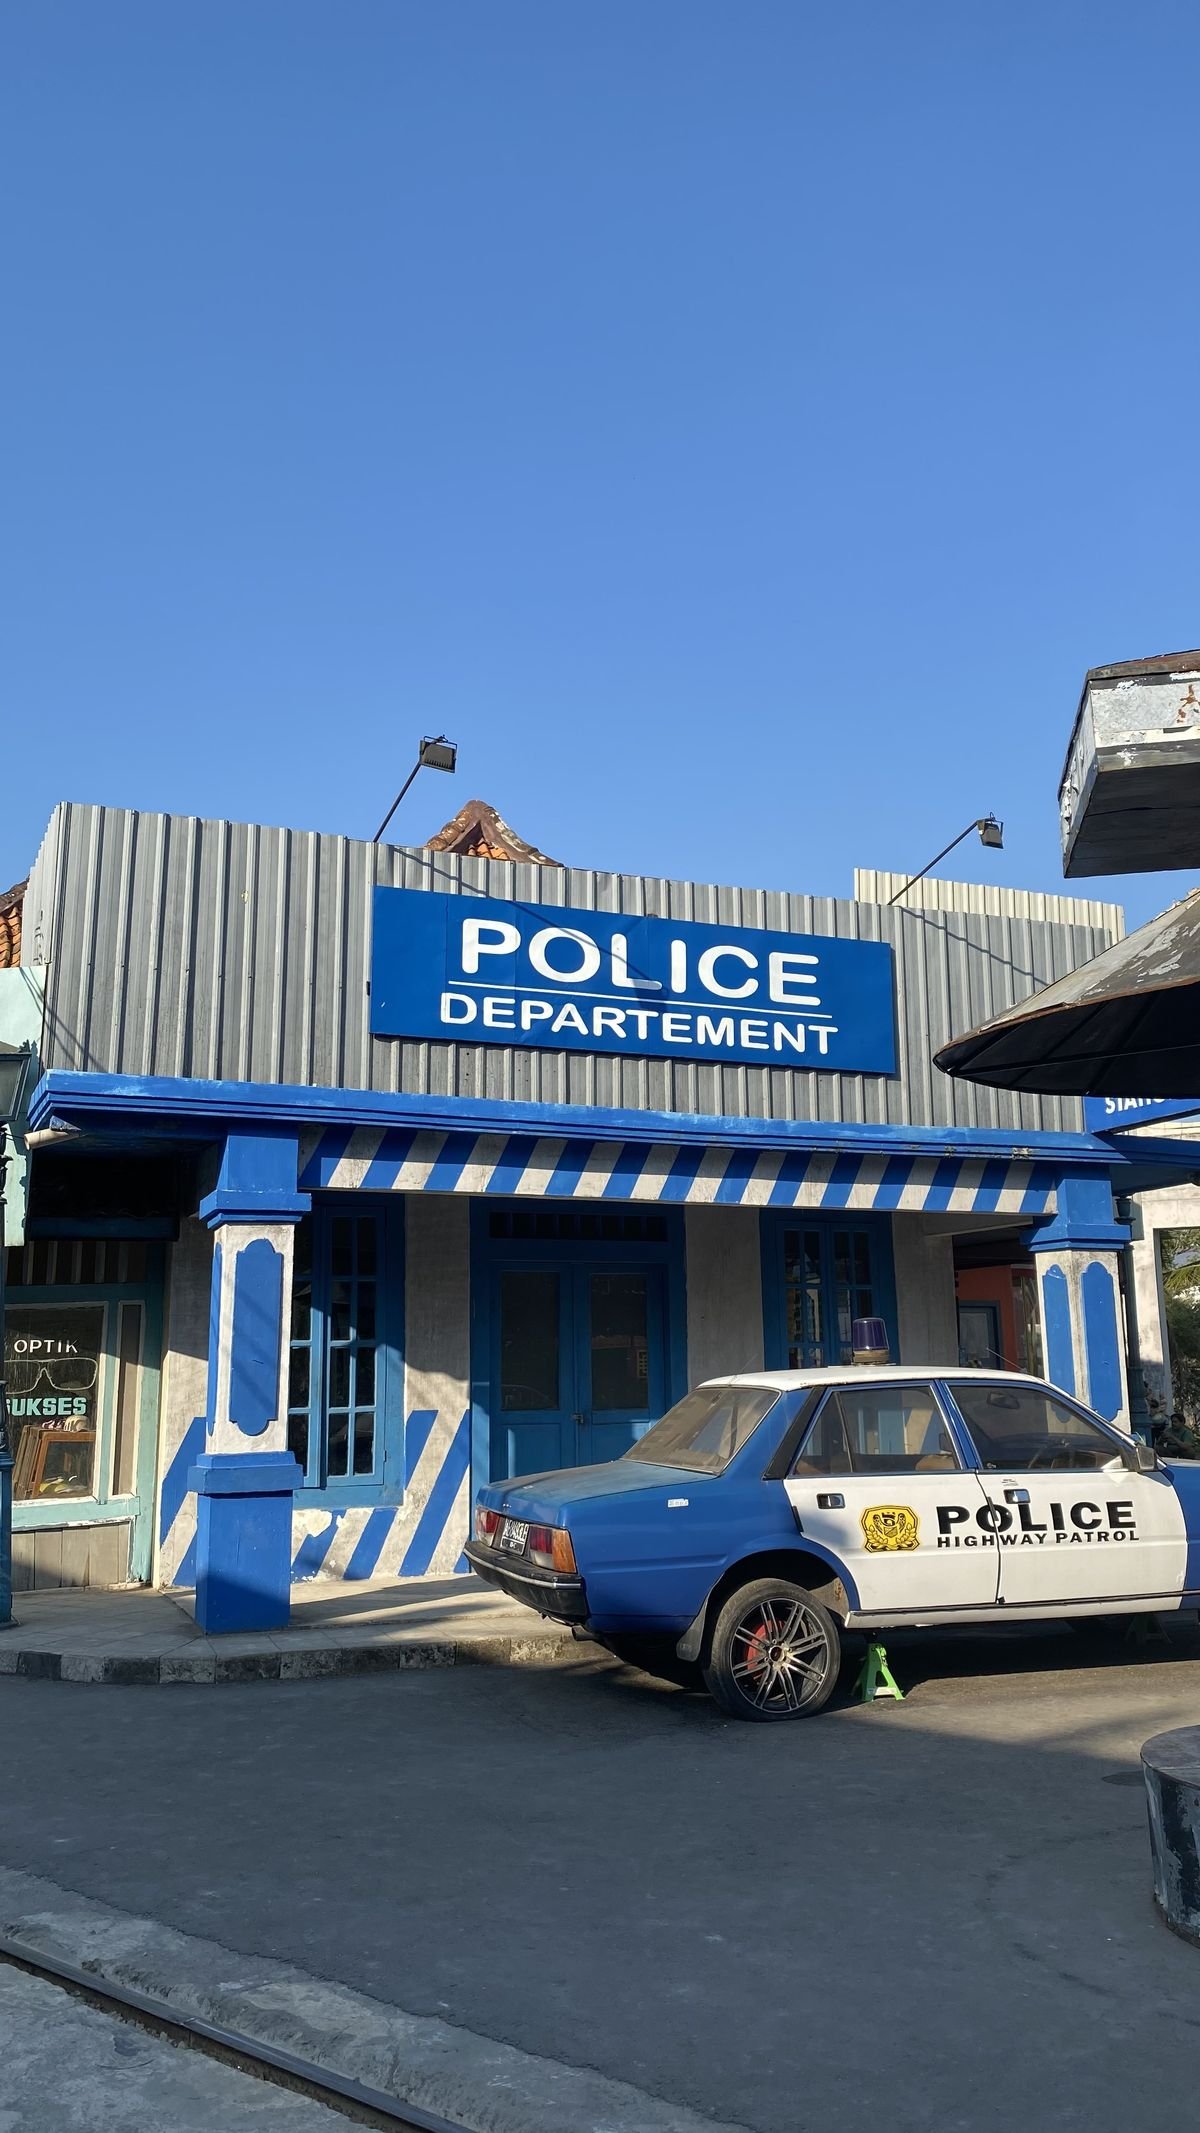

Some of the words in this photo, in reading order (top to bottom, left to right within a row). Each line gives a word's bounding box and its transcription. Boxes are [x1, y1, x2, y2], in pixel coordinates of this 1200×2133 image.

[462, 918, 822, 1006] POLICE
[440, 992, 838, 1055] DEPARTEMENT
[14, 1339, 78, 1353] OPTIK
[936, 1501, 1137, 1534] POLICE
[937, 1534, 1047, 1548] HIGHWAY
[1056, 1530, 1140, 1544] PATROL
